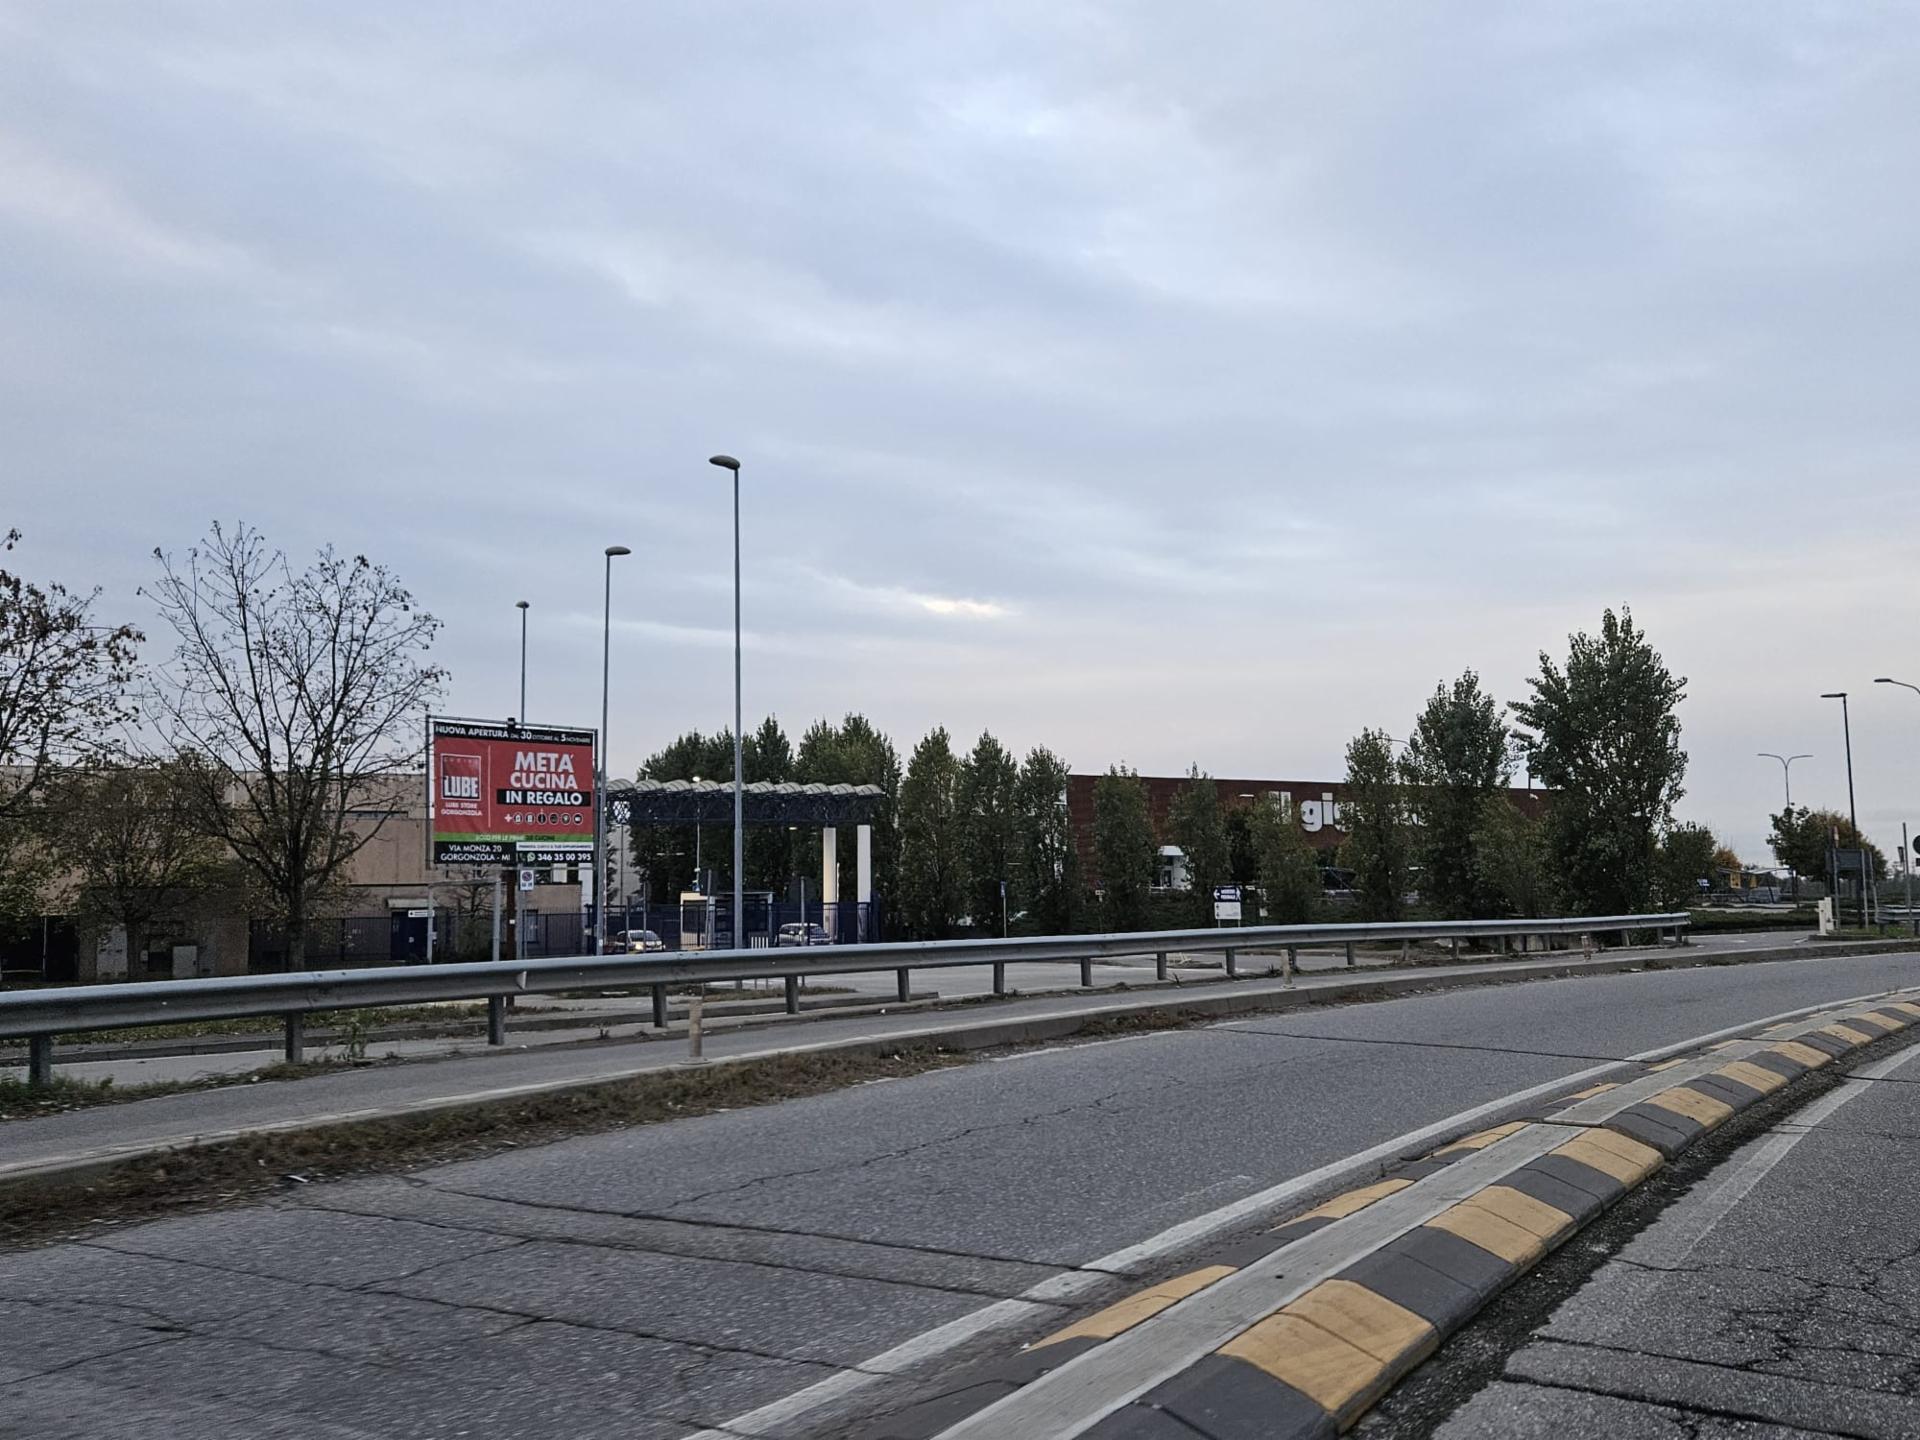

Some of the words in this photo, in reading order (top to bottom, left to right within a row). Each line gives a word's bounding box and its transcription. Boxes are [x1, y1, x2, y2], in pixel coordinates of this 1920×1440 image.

[435, 725, 465, 735] NUOVA
[468, 728, 508, 738] APERTURA
[520, 731, 532, 740] 30
[561, 734, 566, 742] 5
[444, 776, 478, 798] LUBE
[510, 772, 578, 789] CUCINA
[506, 791, 522, 803] IN
[527, 792, 582, 805] REGALO
[440, 853, 495, 861] GORGONZOLA
[537, 853, 552, 861] 346
[554, 853, 564, 861] 35
[566, 853, 575, 861] 00
[577, 853, 591, 861] 395
